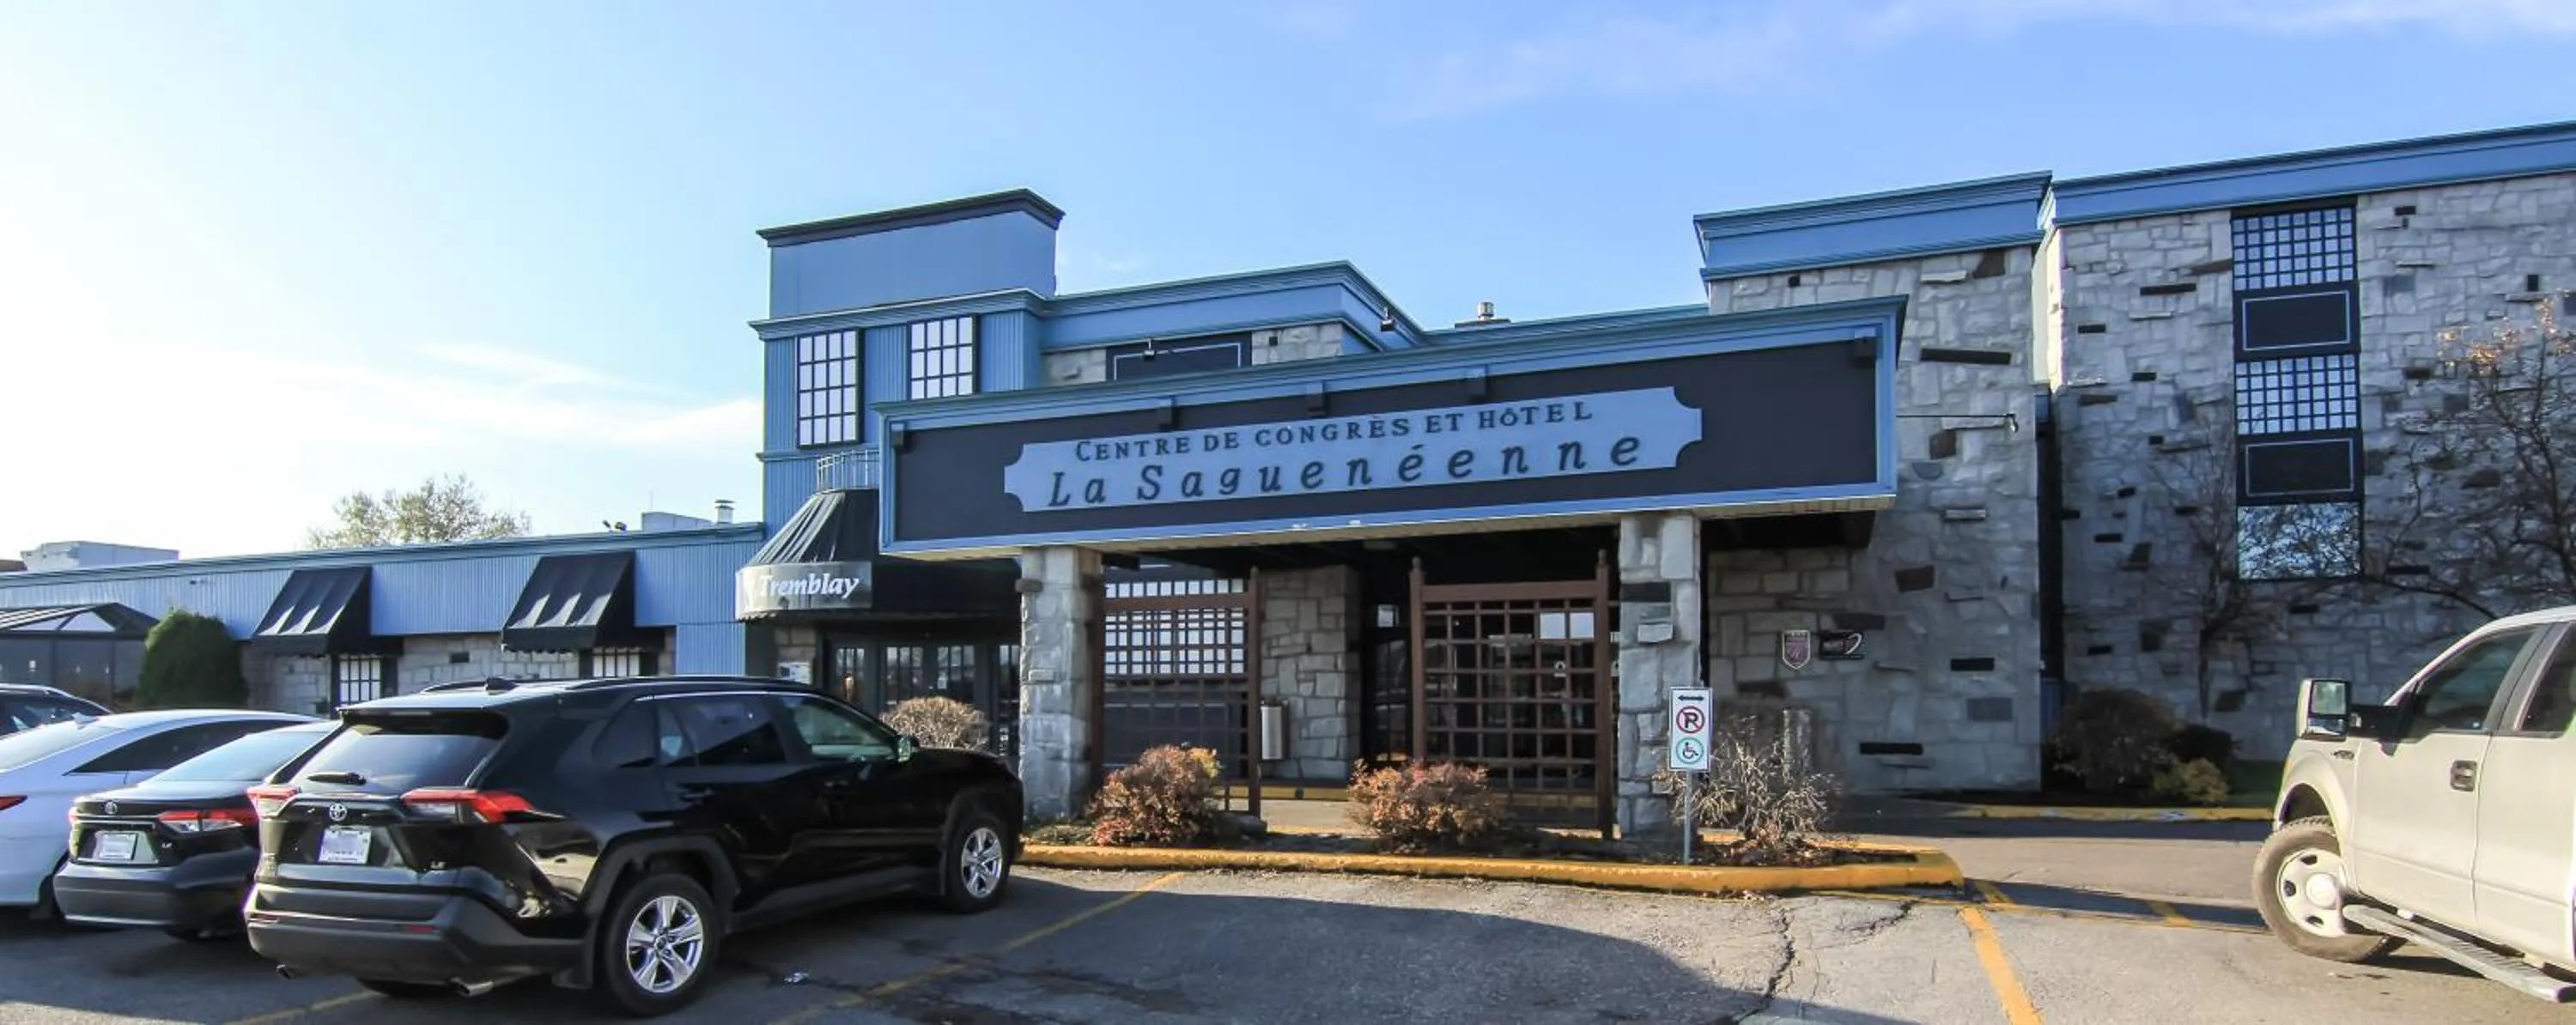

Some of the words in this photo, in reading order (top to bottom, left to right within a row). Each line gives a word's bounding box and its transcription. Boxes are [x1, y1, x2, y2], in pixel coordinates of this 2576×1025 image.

[1075, 436, 1191, 462] CENTRE
[1203, 432, 1239, 452] DE
[1425, 413, 1464, 434] ET
[1478, 401, 1593, 430] HÔTEL
[1048, 471, 1106, 506] La
[1136, 436, 1640, 500] Saguenéenne
[759, 573, 860, 599] Tremblay
